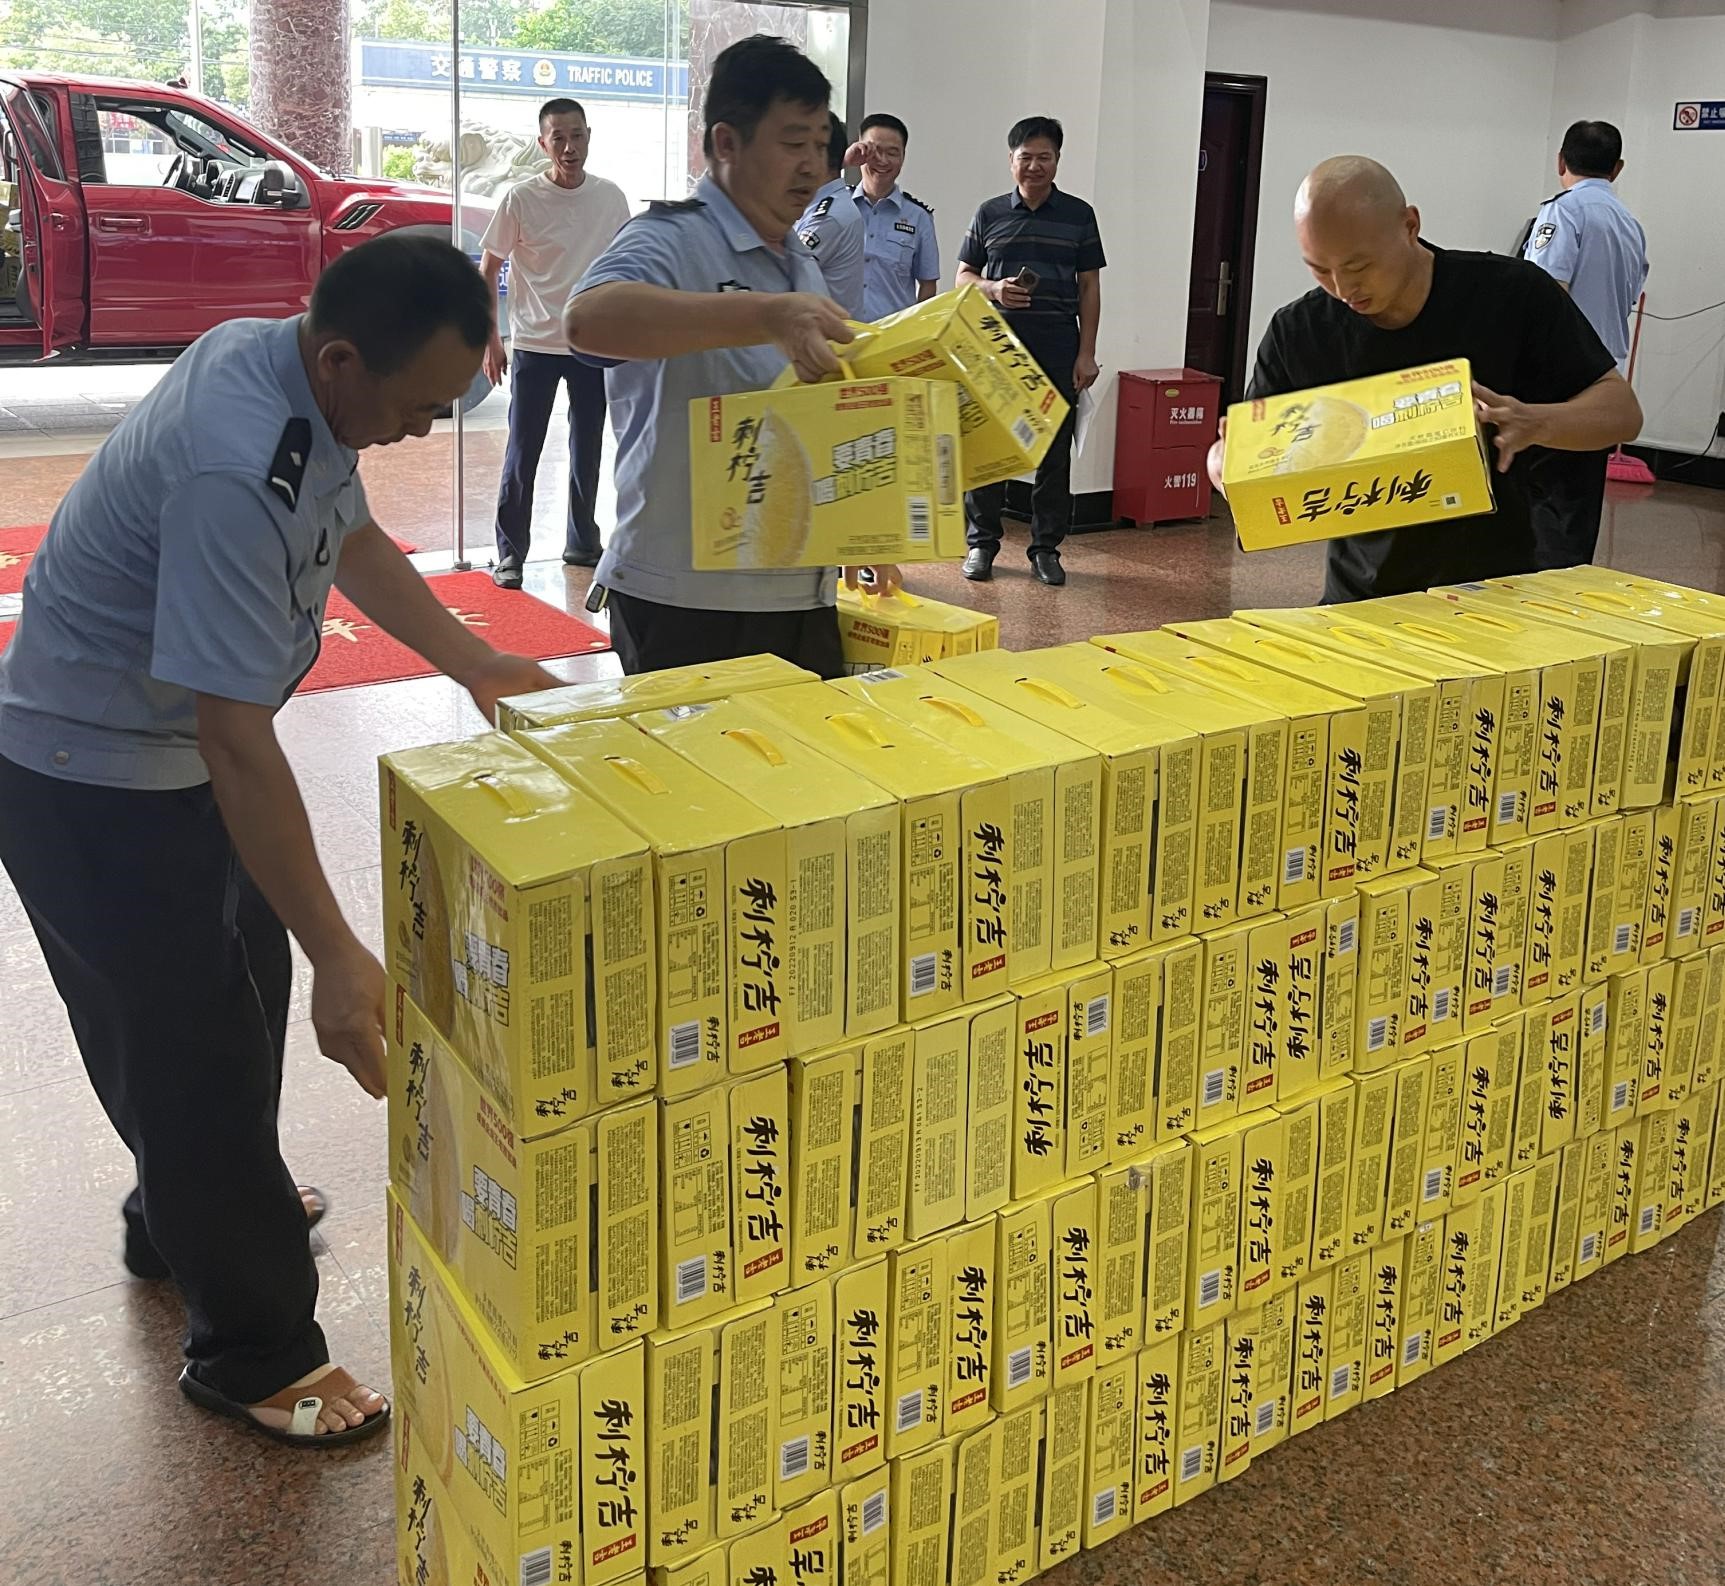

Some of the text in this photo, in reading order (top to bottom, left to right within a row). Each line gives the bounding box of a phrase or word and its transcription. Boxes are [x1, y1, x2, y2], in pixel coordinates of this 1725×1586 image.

[431, 54, 521, 81] 交通警察
[568, 65, 653, 87] TRAFFIC POLICE
[1164, 473, 1196, 488] 火警119
[1298, 469, 1432, 521] 刺柠吉
[1469, 708, 1496, 812] 刺柠吉
[1540, 697, 1564, 796] 刺柠吉
[1335, 748, 1361, 858] 刺柠吉
[974, 823, 1007, 948] 刺柠吉
[1534, 870, 1556, 967] 刺柠吉
[740, 878, 781, 1016] 刺柠吉
[1406, 918, 1433, 1019] 刺柠吉
[1475, 892, 1498, 993] 刺柠吉
[1253, 959, 1279, 1069] 刺柠吉
[1287, 954, 1311, 1059] 刺柠吉
[1647, 993, 1666, 1080] 刺柠吉
[1024, 1039, 1054, 1156] 刺柠吉
[1465, 1067, 1489, 1165] 刺柠吉
[1549, 1031, 1568, 1119] 刺柠吉
[744, 1117, 783, 1242] 刺柠吉
[1250, 1159, 1274, 1264] 刺柠吉
[956, 1267, 987, 1382] 刺柠吉
[1063, 1228, 1094, 1339] 刺柠吉
[1375, 1266, 1397, 1359] 刺柠吉
[1444, 1232, 1469, 1324] 刺柠吉
[847, 1310, 880, 1429] 刺柠吉
[1231, 1338, 1253, 1437] 刺柠吉
[1302, 1296, 1329, 1391] 刺柠吉
[594, 1400, 637, 1528] 刺柠吉
[1145, 1374, 1170, 1475] 刺柠吉
